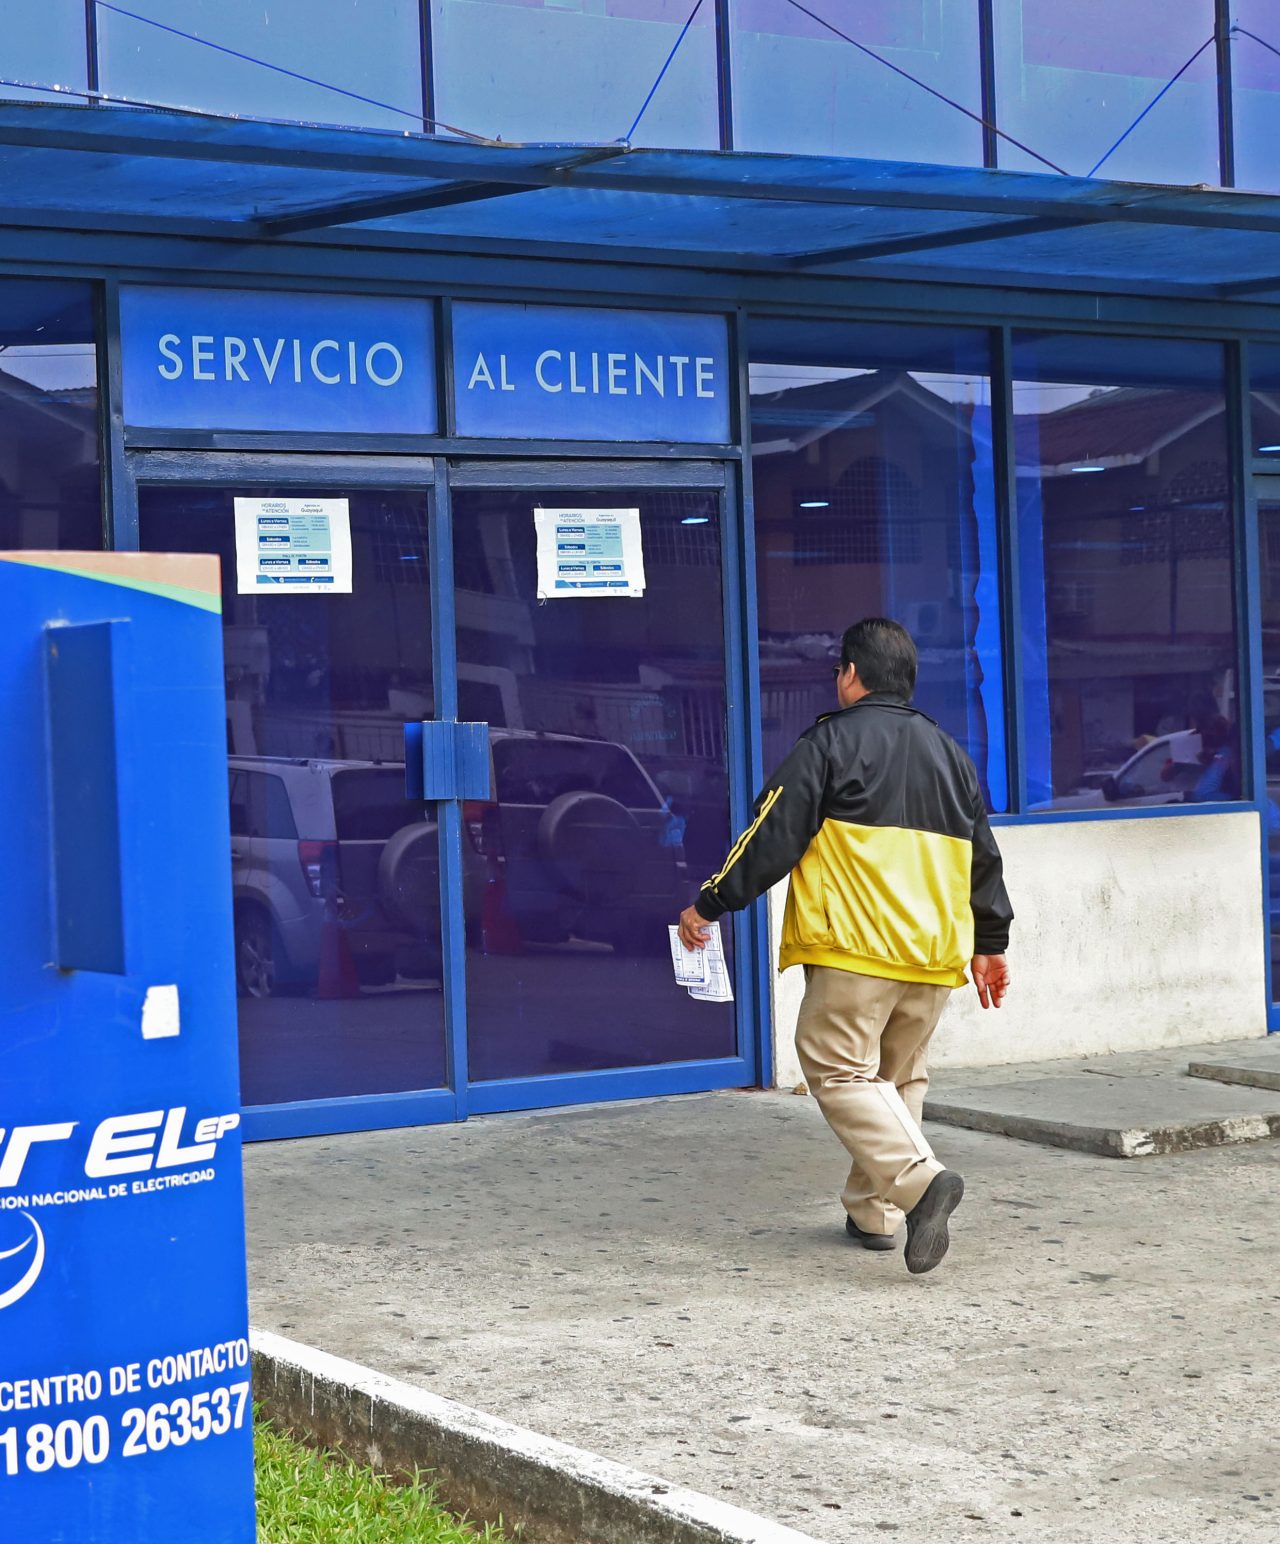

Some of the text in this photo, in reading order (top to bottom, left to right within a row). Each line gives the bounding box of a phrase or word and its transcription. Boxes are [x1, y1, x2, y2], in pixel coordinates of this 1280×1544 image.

[157, 333, 403, 387] SERVICIO
[468, 349, 716, 399] AL CLIENTE
[194, 1113, 241, 1143] EP
[32, 1188, 107, 1208] NACIONAL
[109, 1183, 128, 1197] DE
[132, 1168, 215, 1195] ELECTRICIDAD
[109, 1363, 141, 1396] DE
[147, 1338, 249, 1388] CONTACTO
[121, 1381, 250, 1457] 263537
